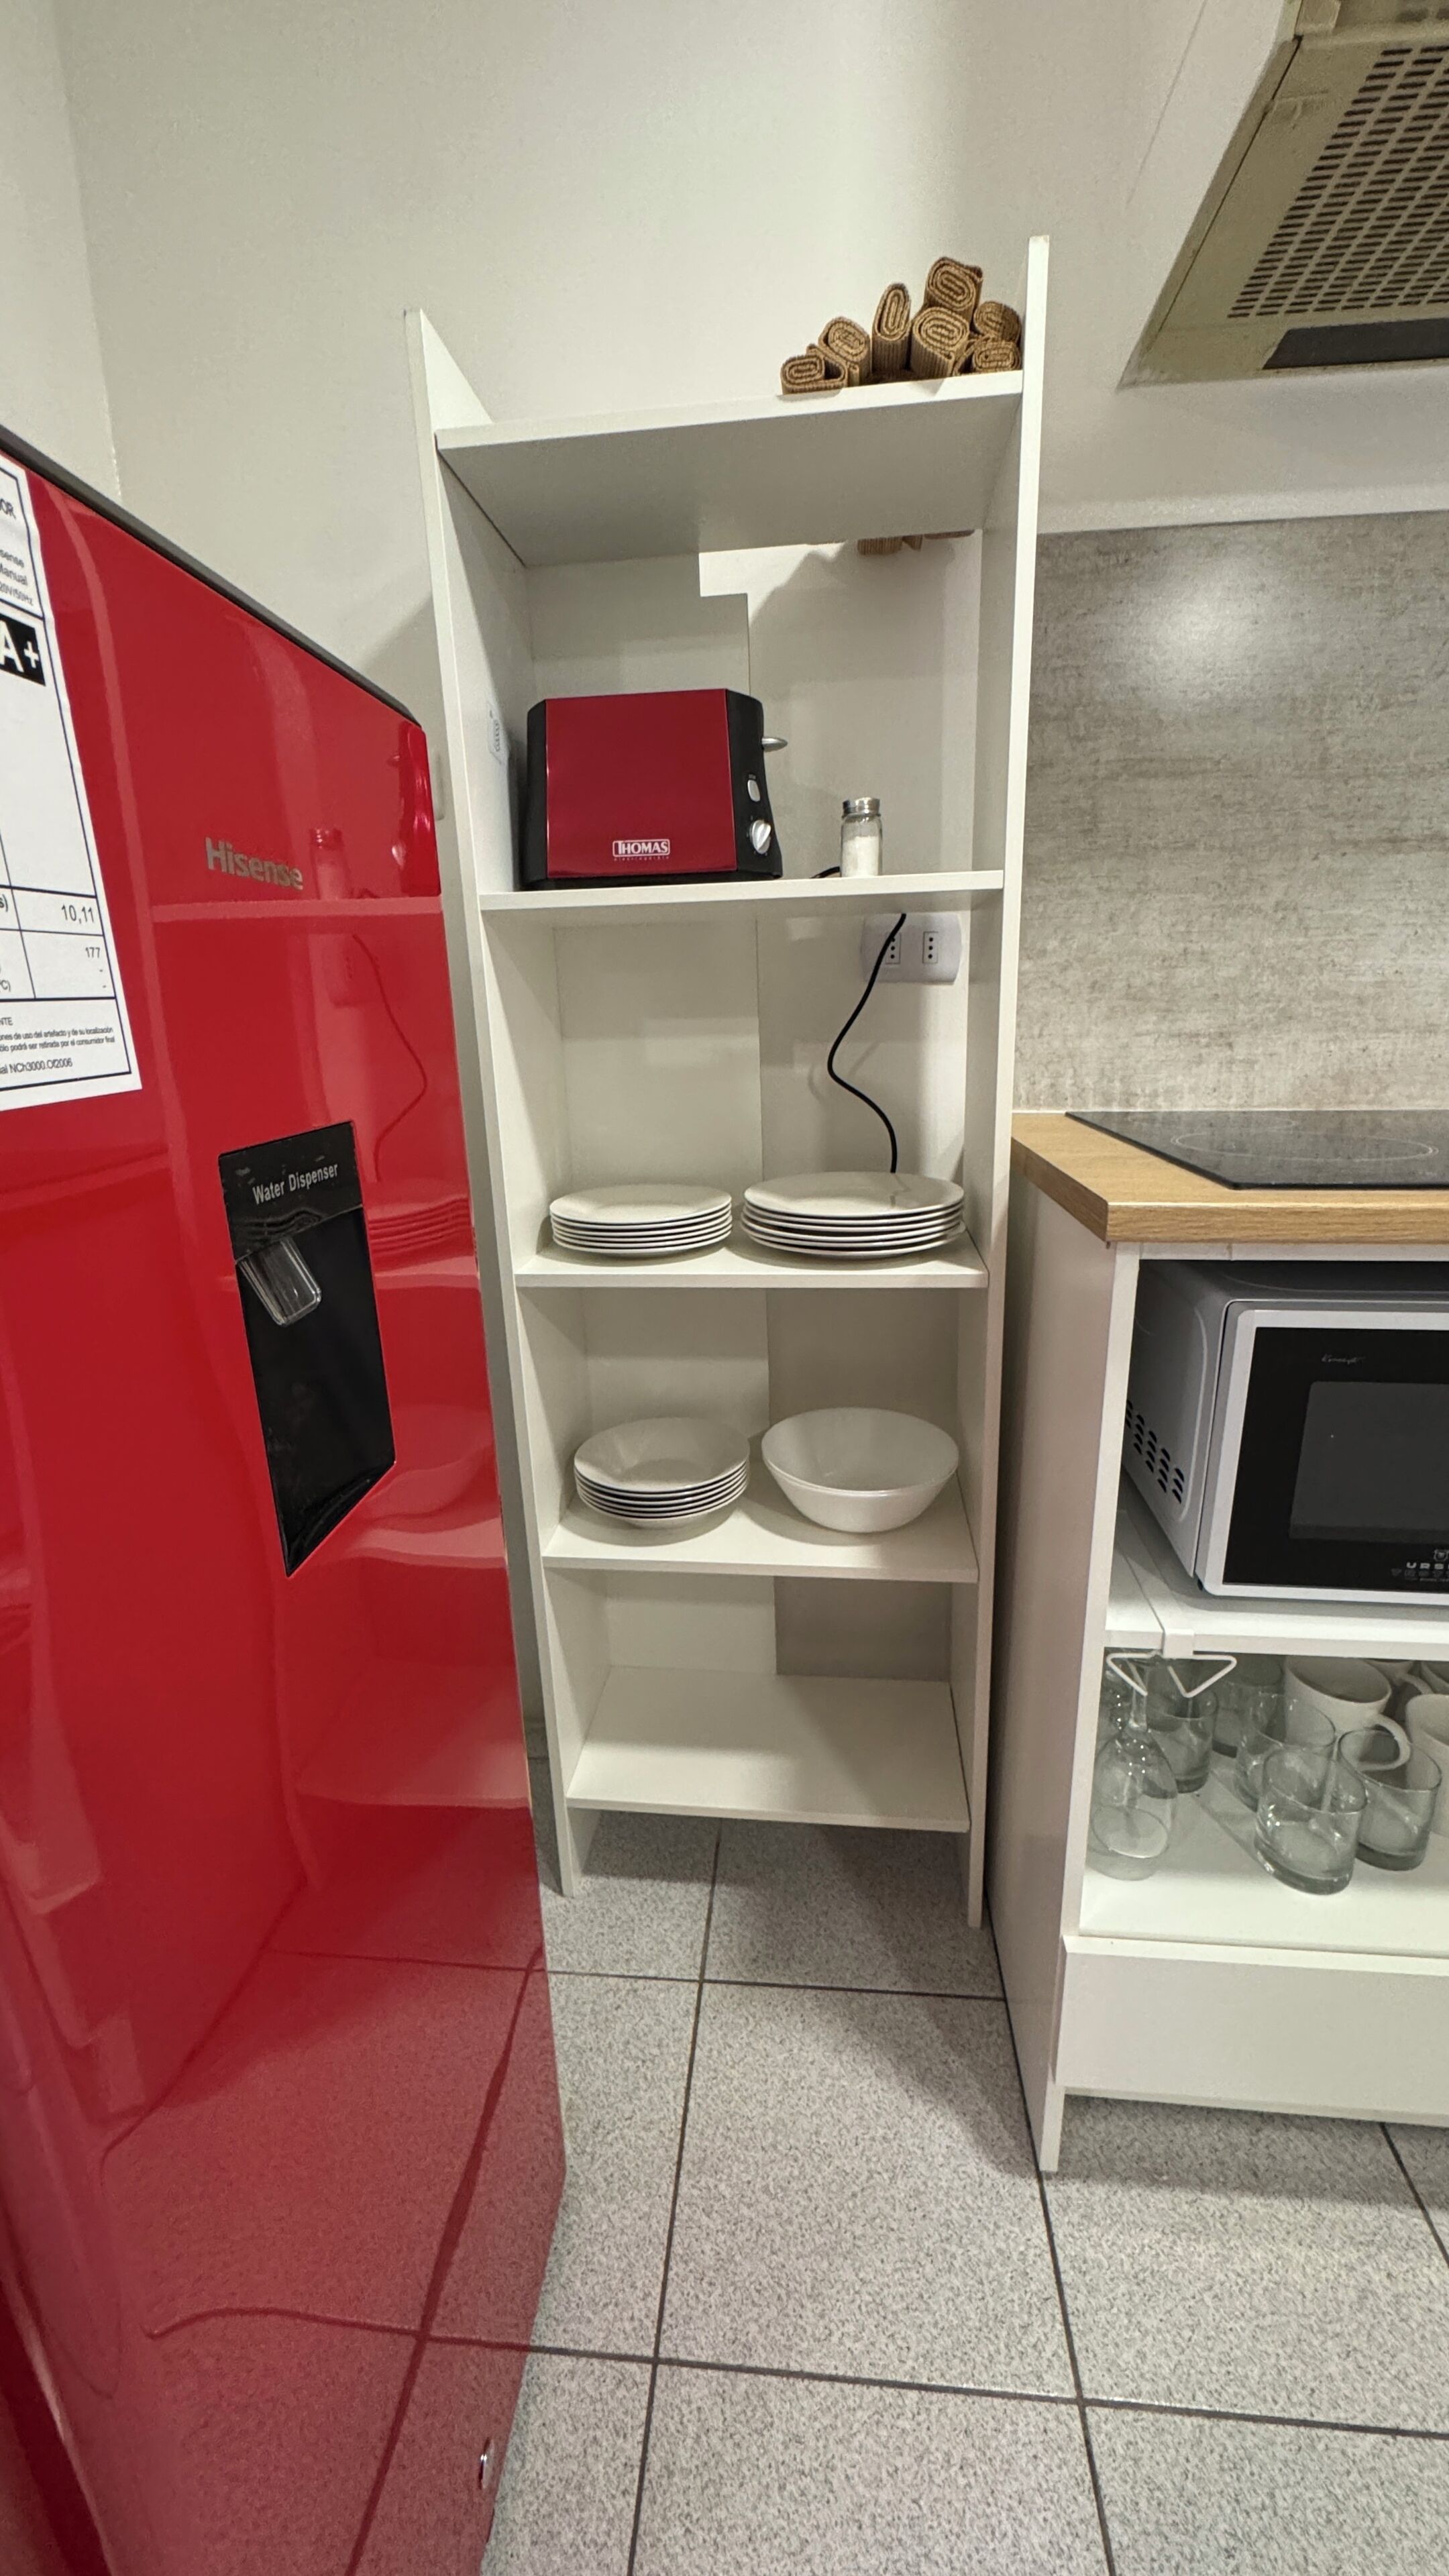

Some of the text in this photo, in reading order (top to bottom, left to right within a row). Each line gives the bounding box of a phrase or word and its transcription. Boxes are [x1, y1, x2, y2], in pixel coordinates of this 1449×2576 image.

[0, 619, 40, 673] A+
[617, 841, 668, 855] THOMAS
[205, 837, 303, 891] Hisense
[61, 904, 95, 924] 10,11
[85, 947, 101, 959] 177
[253, 1164, 337, 1204] Water Dispenser
